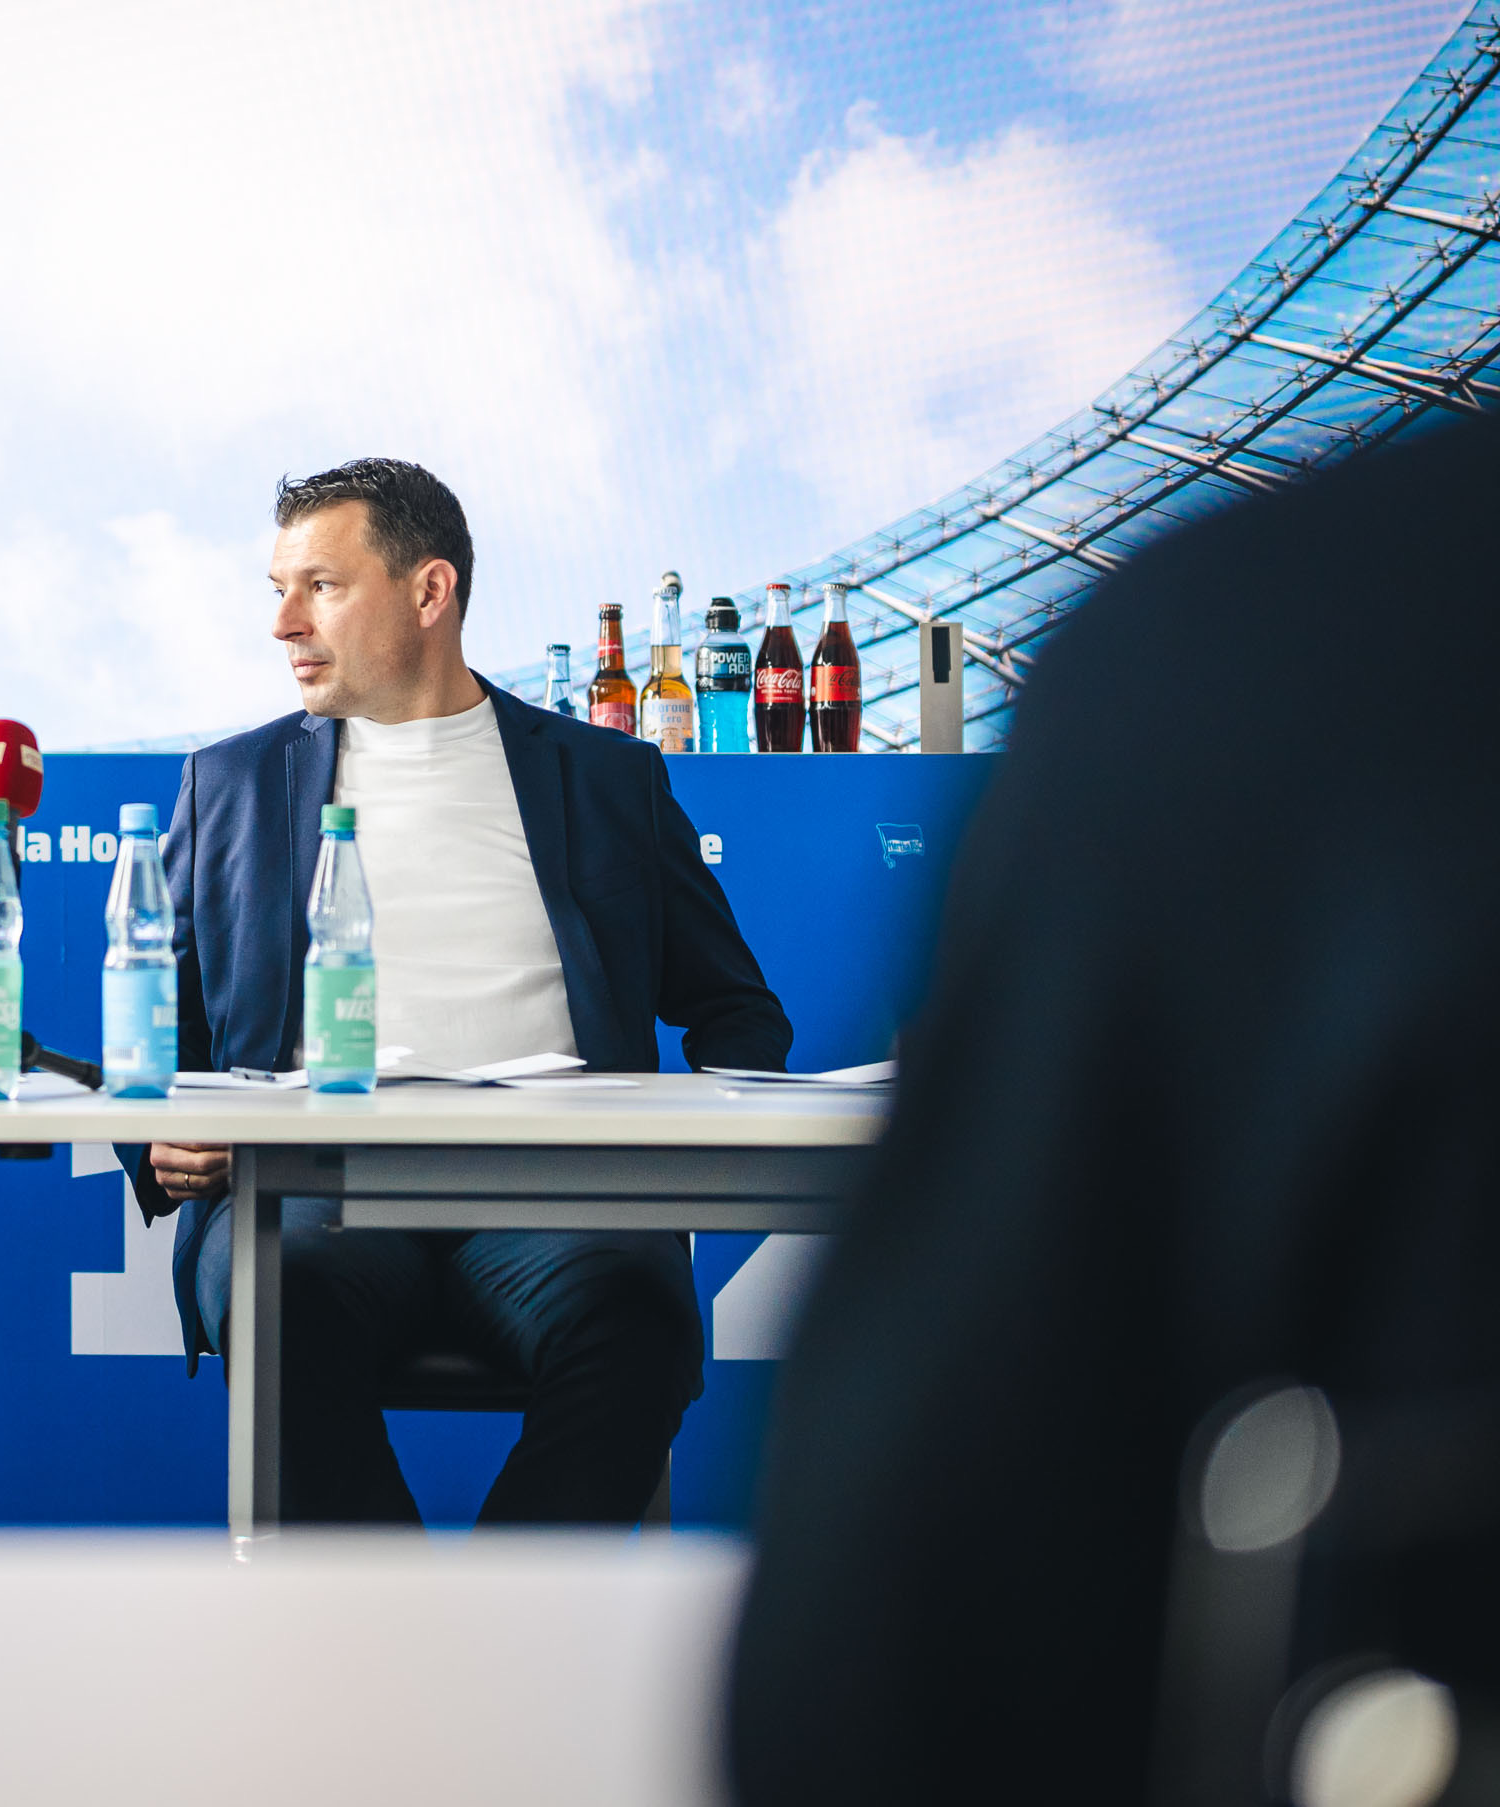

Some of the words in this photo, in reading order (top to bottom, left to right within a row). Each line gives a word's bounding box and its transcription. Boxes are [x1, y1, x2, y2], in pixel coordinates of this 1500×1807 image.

[711, 651, 750, 664] POWER
[756, 669, 801, 689] Coca-Cola
[59, 825, 118, 863] Ho
